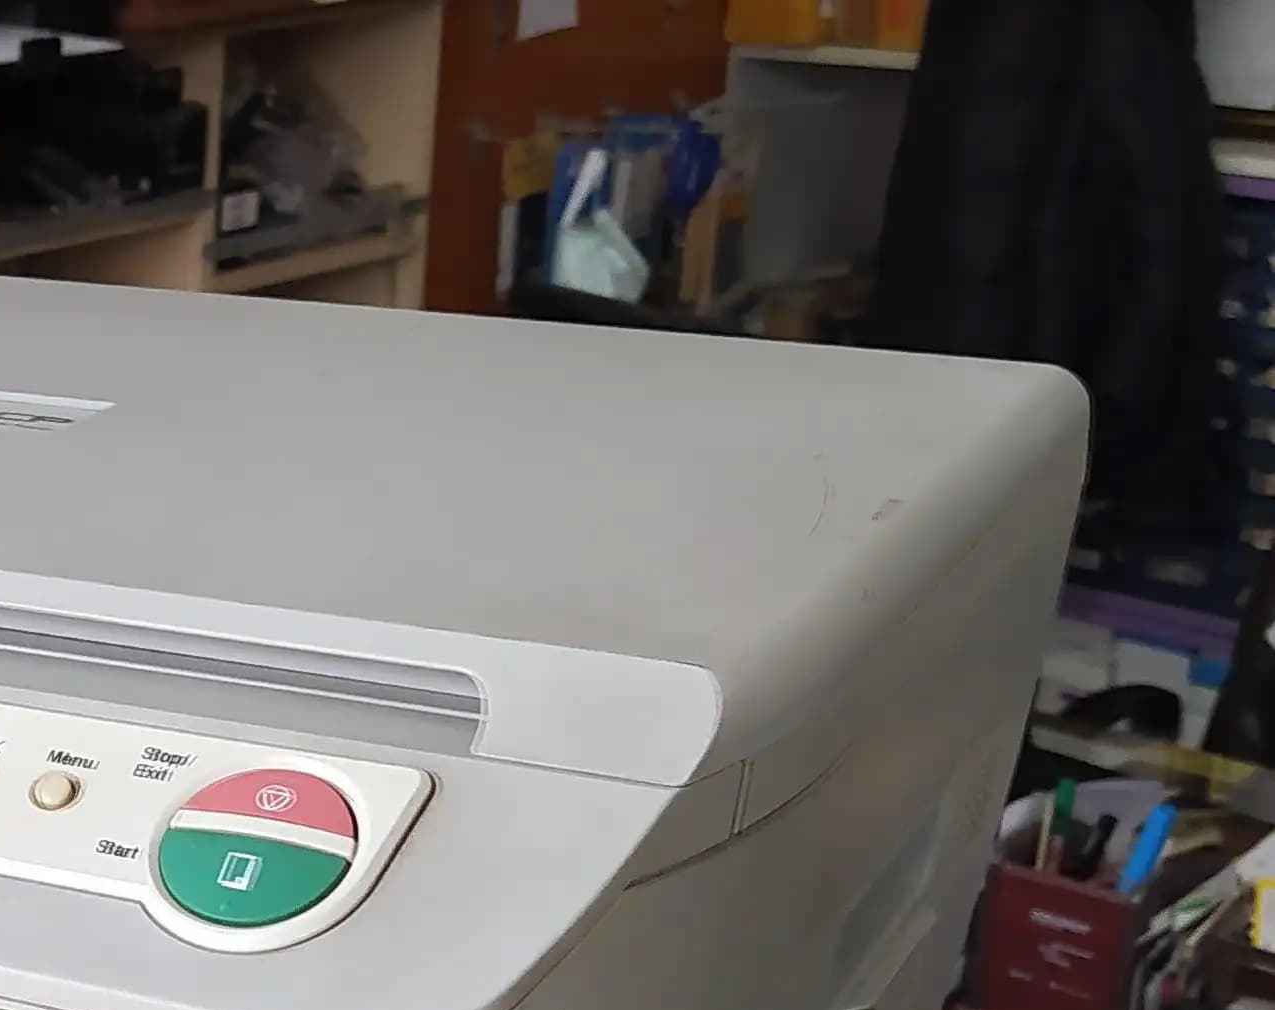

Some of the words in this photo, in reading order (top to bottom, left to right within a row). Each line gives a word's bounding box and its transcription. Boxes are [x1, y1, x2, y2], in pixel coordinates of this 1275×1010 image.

[46, 750, 100, 770] Menu
[132, 764, 173, 782] Exit
[95, 839, 142, 860] Start
